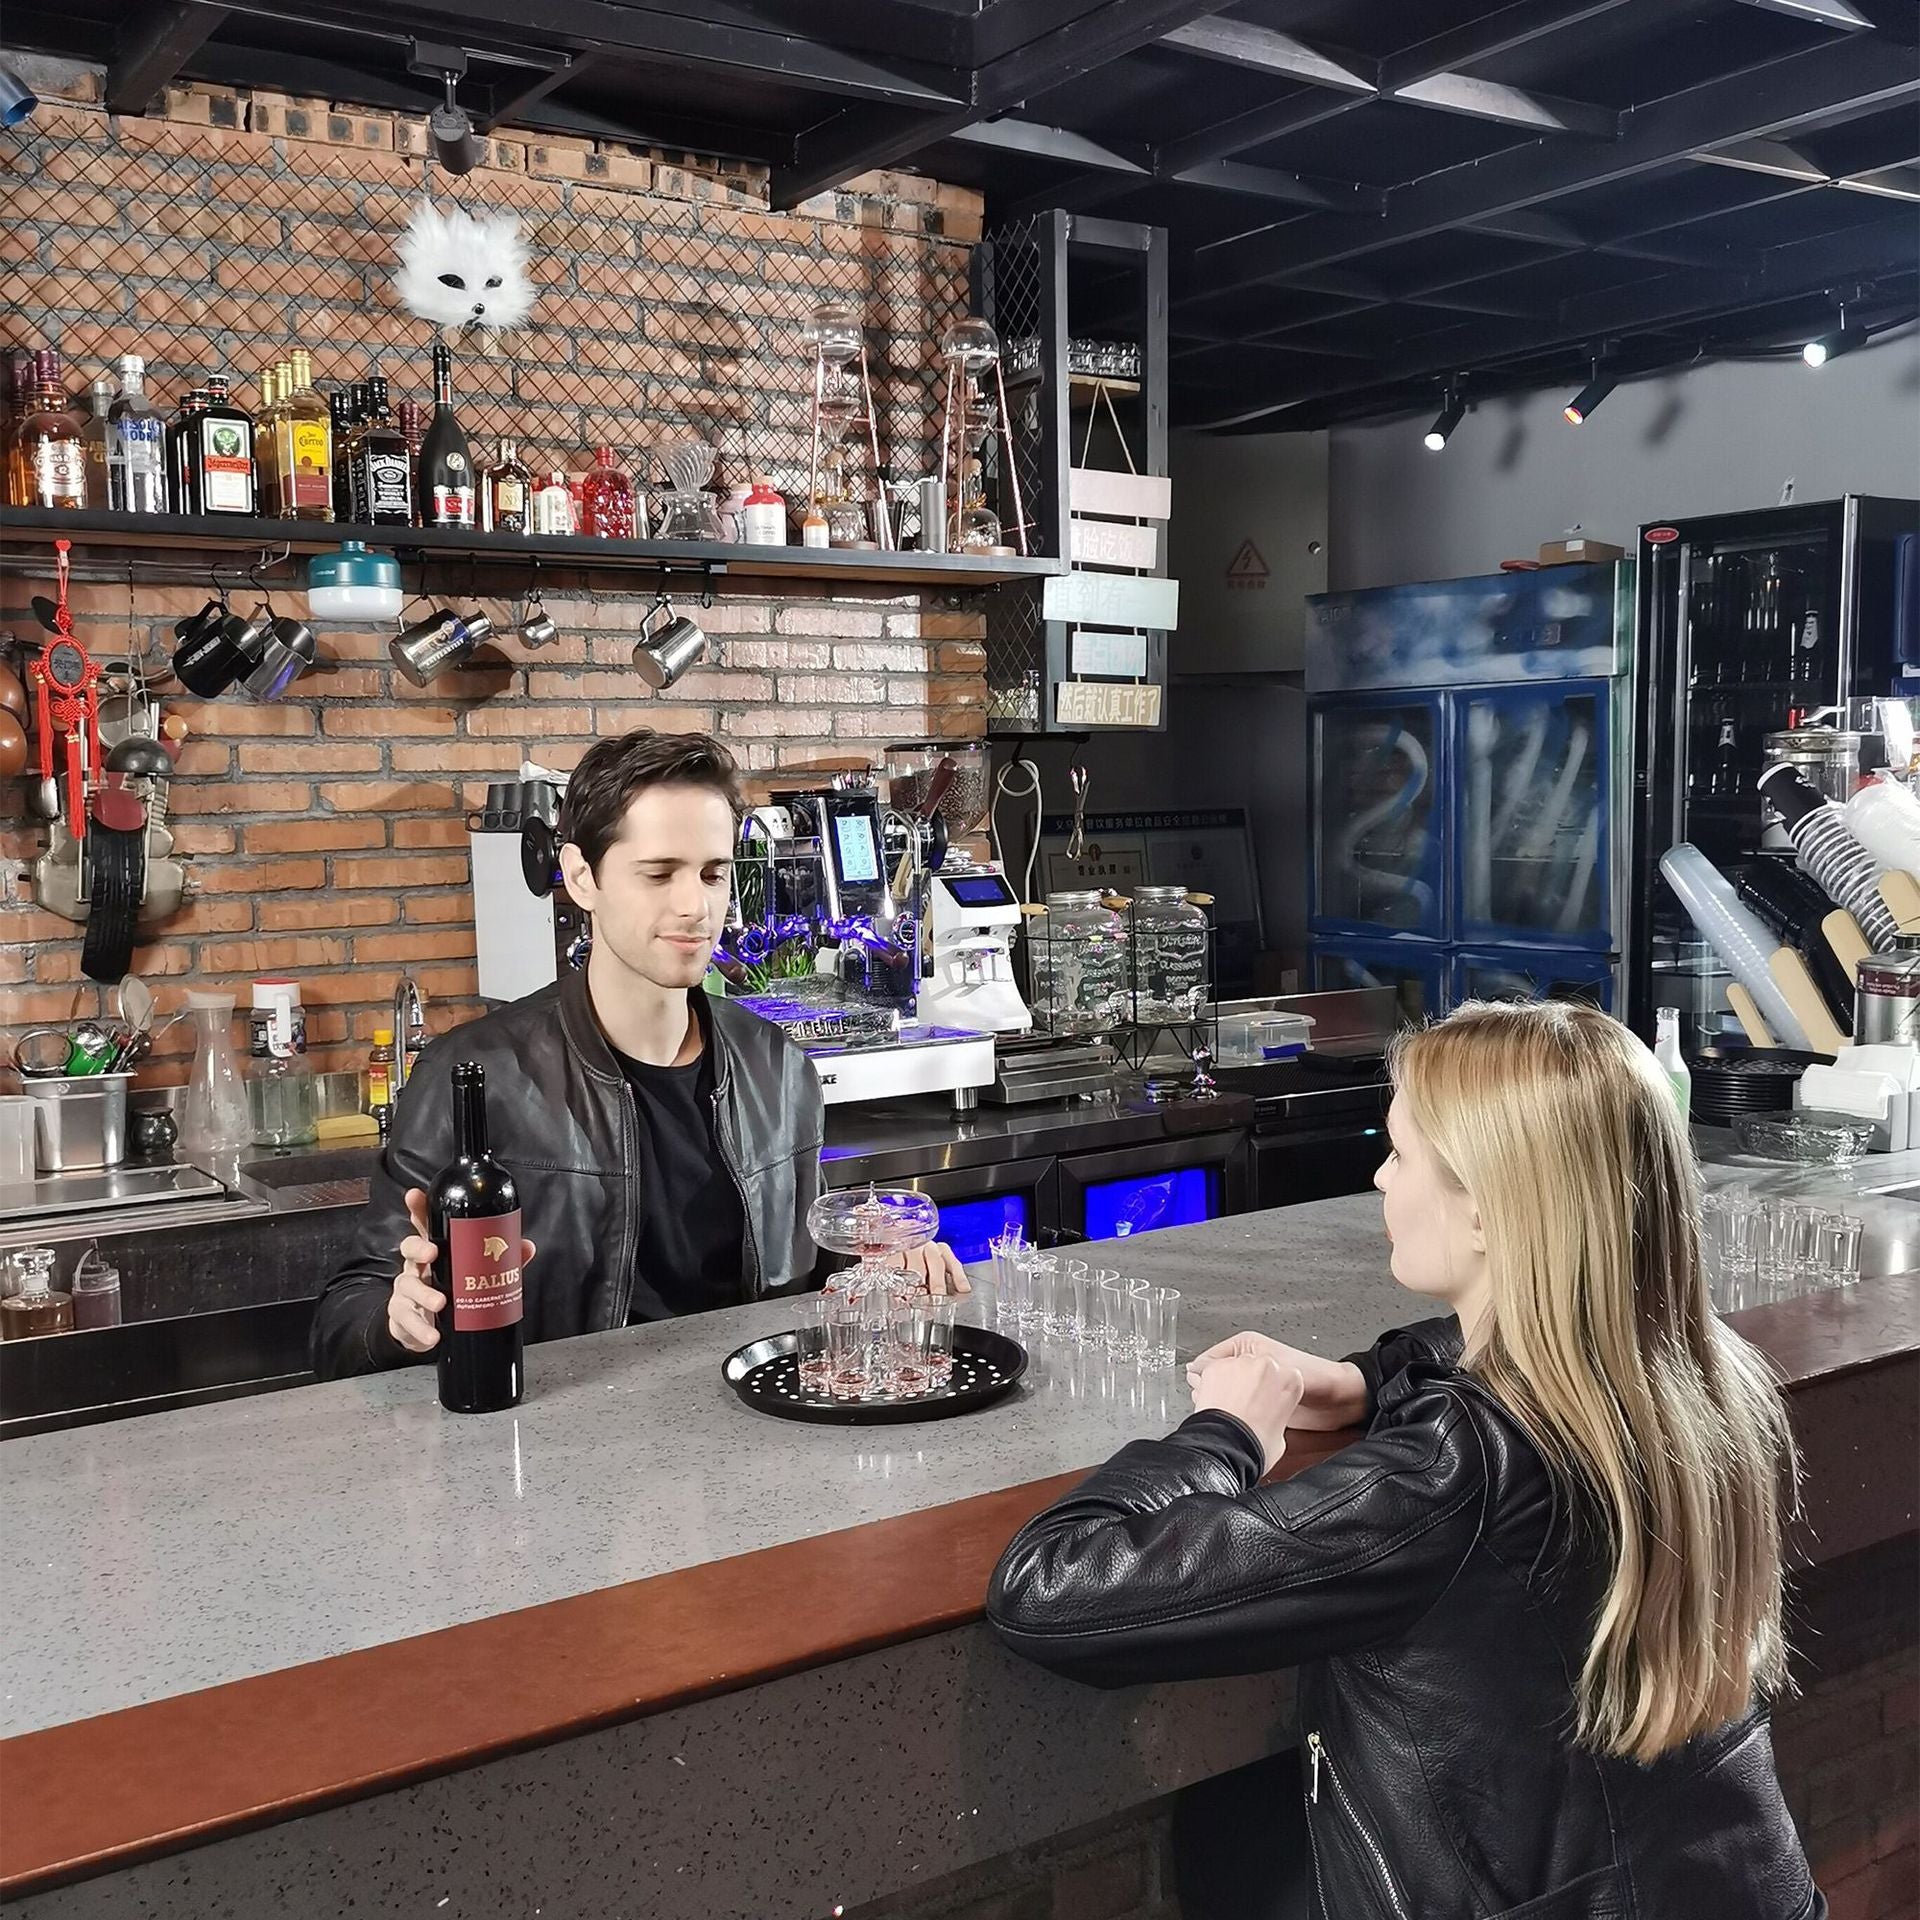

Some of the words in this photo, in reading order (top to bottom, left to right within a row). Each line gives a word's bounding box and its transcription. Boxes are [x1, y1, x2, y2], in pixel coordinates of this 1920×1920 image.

[1060, 686, 1158, 723] 然后就认真工作了
[464, 1267, 520, 1291] BALIUS
